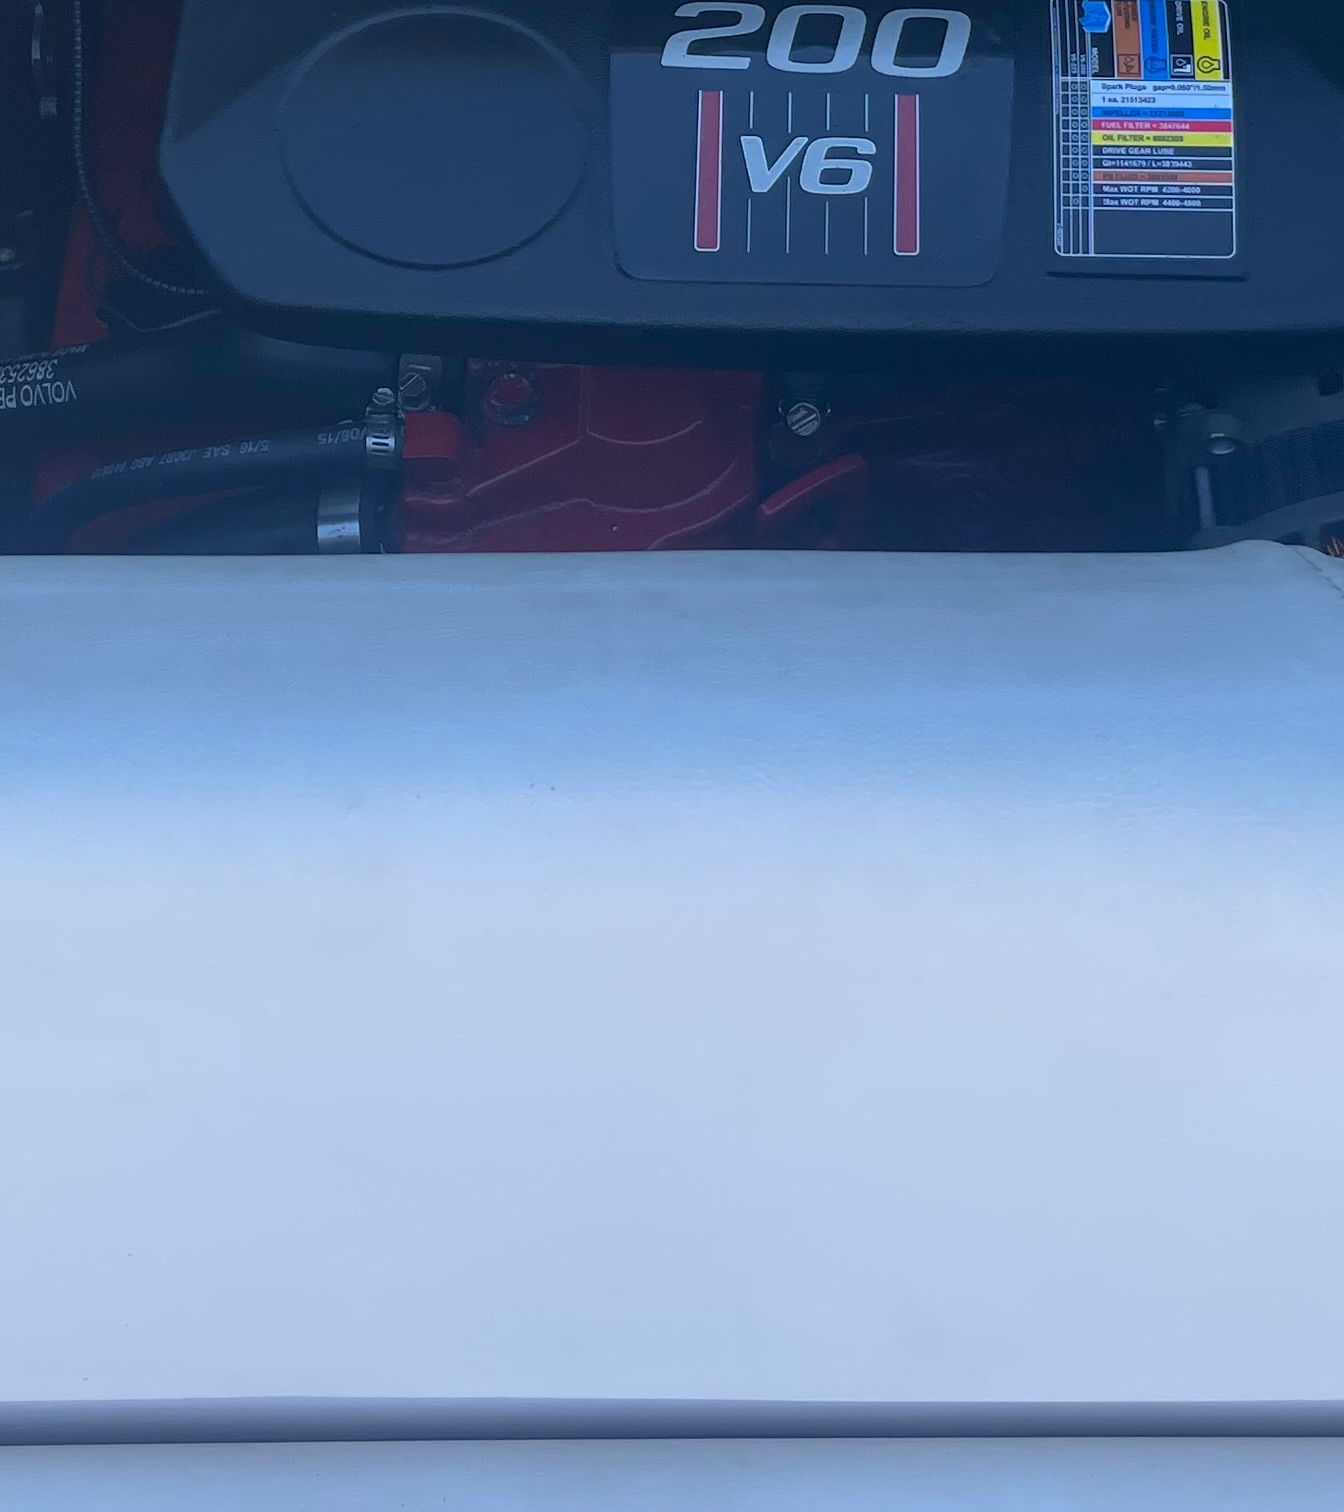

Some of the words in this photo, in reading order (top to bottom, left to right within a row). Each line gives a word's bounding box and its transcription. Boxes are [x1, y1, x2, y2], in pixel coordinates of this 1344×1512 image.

[660, 0, 972, 79] 200
[1101, 121, 1121, 129] FUEL
[740, 135, 877, 196] V6
[20, 380, 77, 406] VOLVO
[202, 444, 231, 458] SAE
